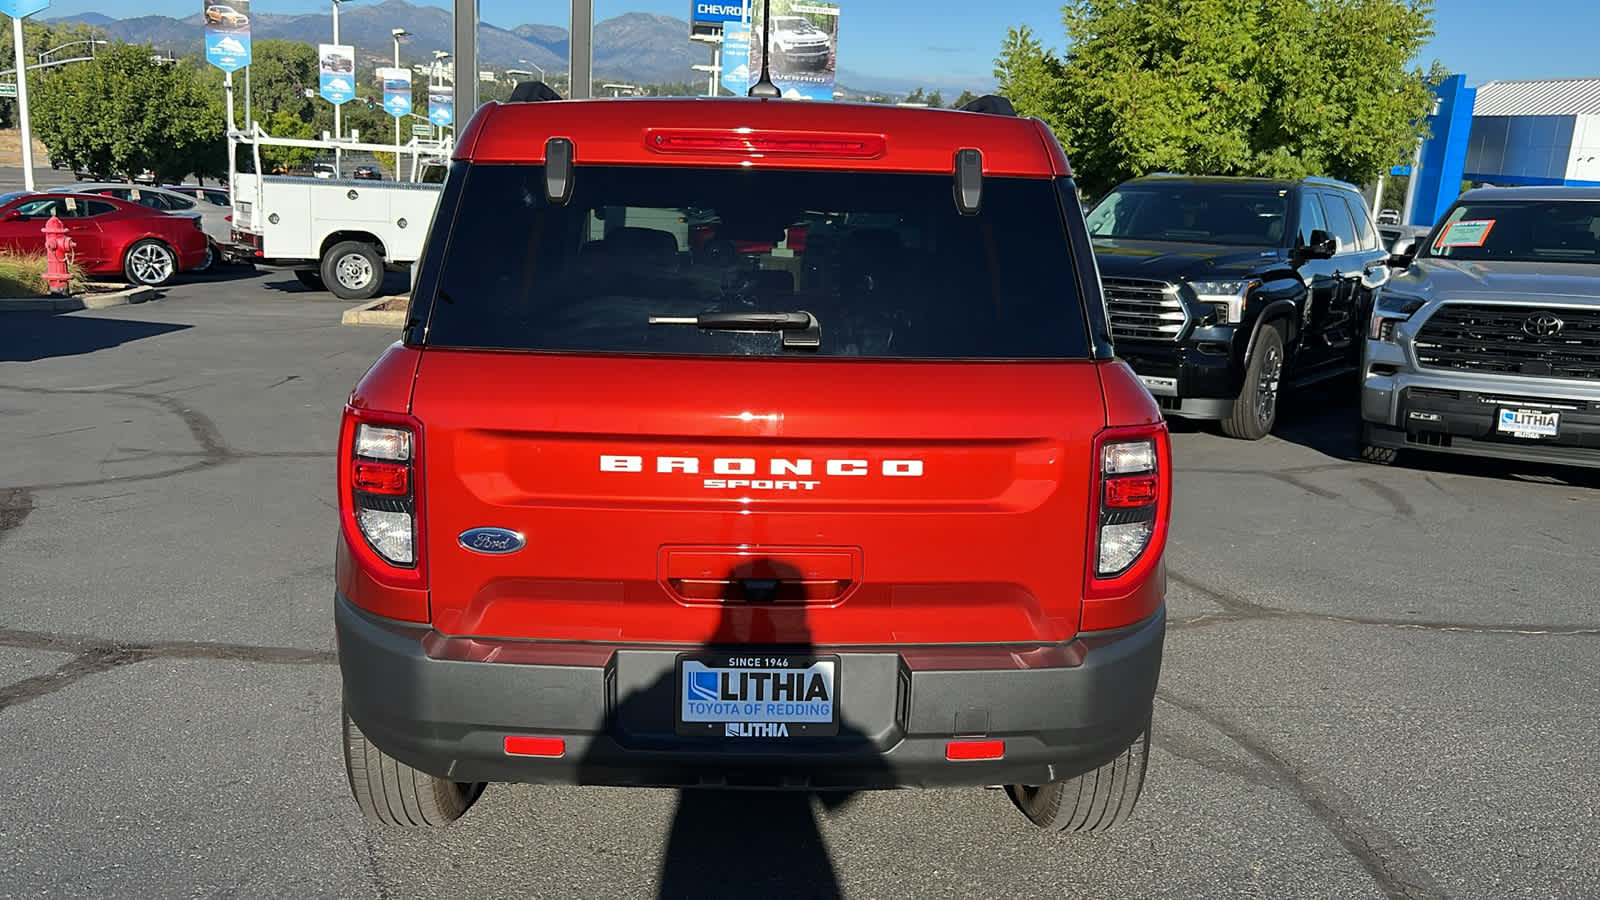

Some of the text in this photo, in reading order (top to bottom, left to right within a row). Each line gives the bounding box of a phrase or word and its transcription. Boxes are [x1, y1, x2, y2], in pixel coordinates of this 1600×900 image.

[698, 4, 745, 16] CHEVRO
[1514, 414, 1555, 426] LITHIA
[600, 455, 924, 477] BRONCO
[703, 479, 820, 490] SPORT
[473, 532, 511, 549] Ford
[728, 657, 789, 667] SINCE 1946
[721, 672, 829, 702] LITHIA
[687, 703, 830, 716] TOYOTA OF REDDING
[739, 723, 789, 737] LITHIA
